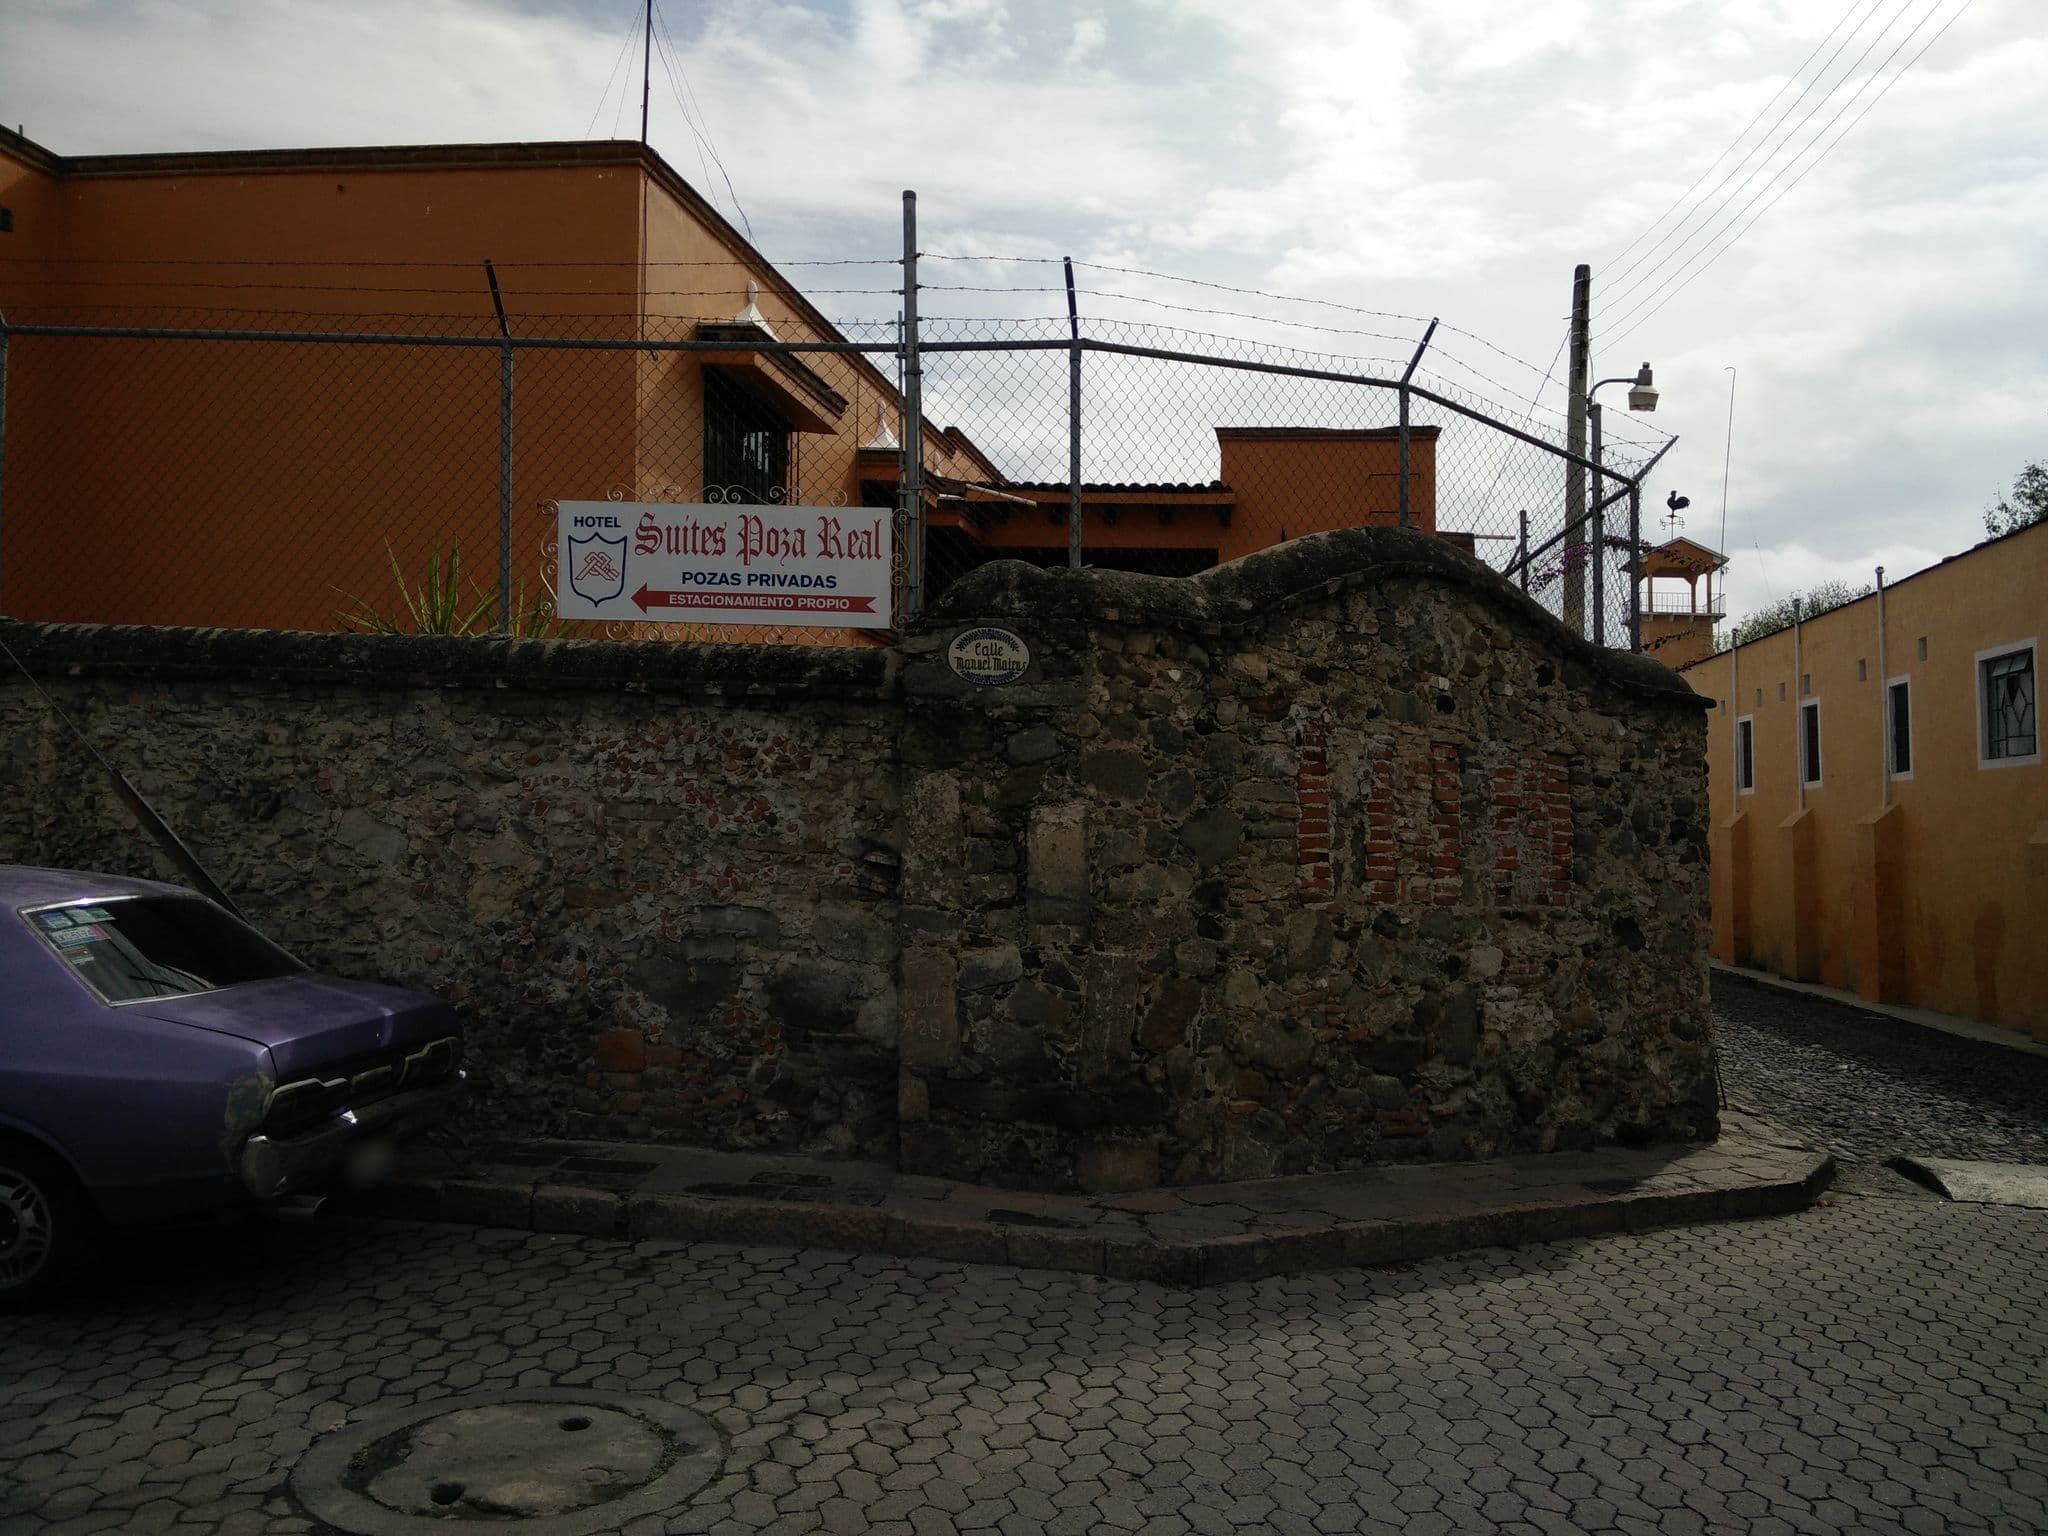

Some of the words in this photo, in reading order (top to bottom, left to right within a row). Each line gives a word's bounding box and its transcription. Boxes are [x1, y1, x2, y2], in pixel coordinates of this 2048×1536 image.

[574, 515, 622, 529] HOTEL
[634, 512, 728, 556] Suites
[736, 513, 807, 566] Poza
[816, 515, 883, 561] Real
[681, 571, 742, 587] POZAS
[747, 573, 838, 589] PRIVADAS
[668, 593, 794, 609] ESTACIONAMIENTO
[797, 597, 851, 610] PROPIO
[975, 642, 1004, 657] Calle
[954, 655, 990, 671] Manuel
